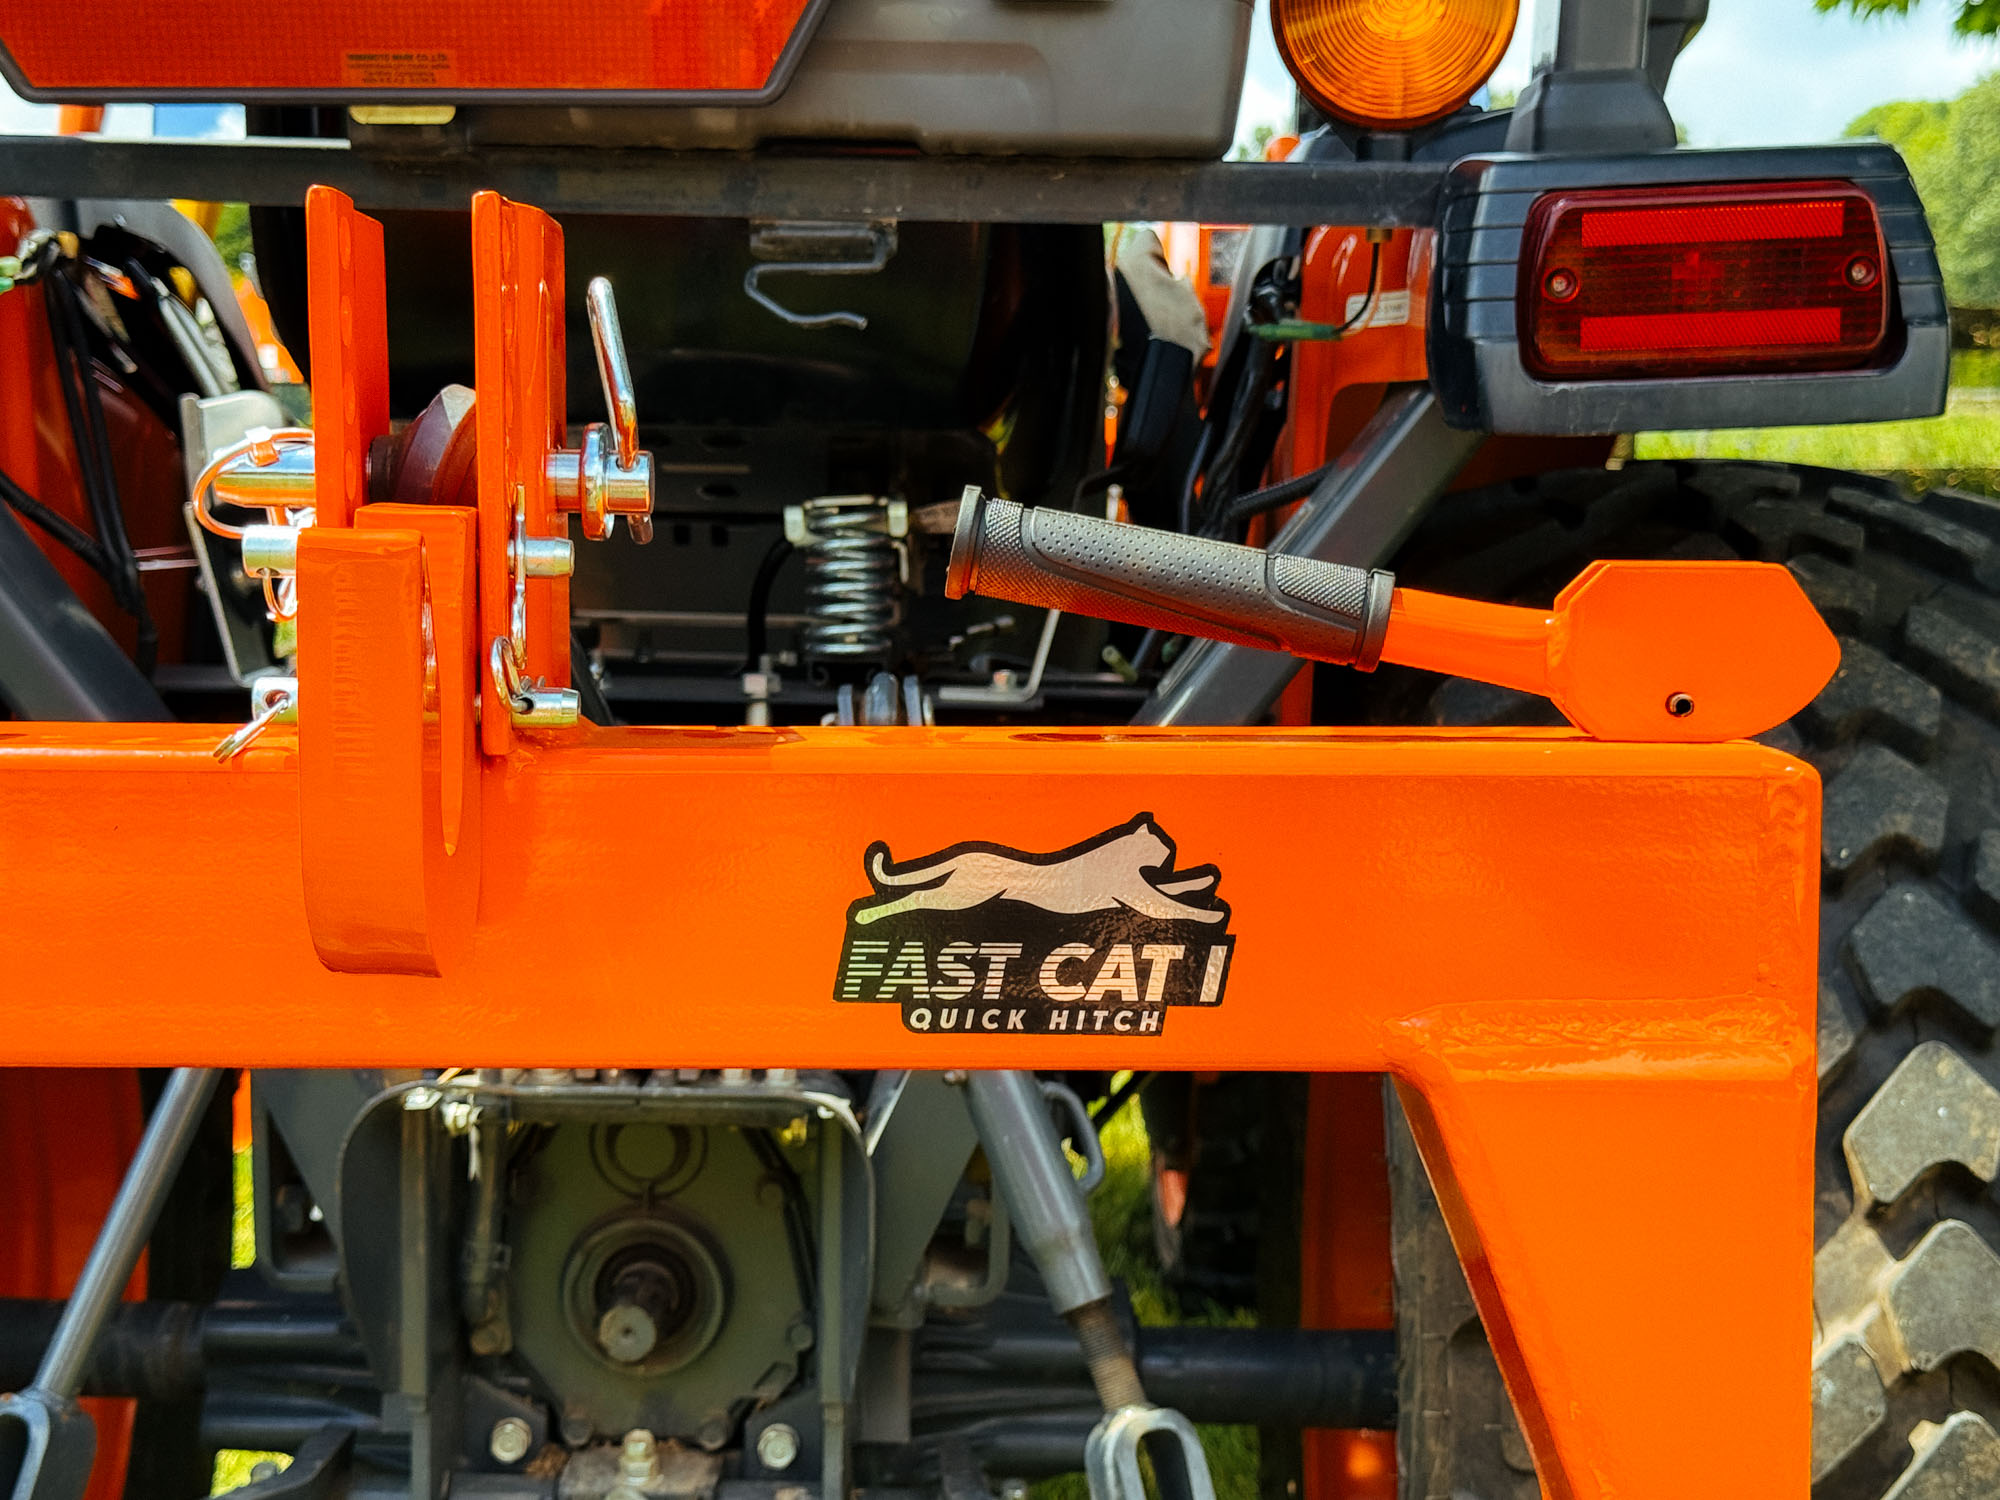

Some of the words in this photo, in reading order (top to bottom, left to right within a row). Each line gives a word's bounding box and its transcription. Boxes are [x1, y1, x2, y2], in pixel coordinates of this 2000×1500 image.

[842, 940, 1023, 999] FAST
[1038, 942, 1186, 1002] CAT
[1199, 945, 1228, 1001] I
[909, 1007, 1027, 1031] QUICK
[1048, 1009, 1161, 1032] HITCH
